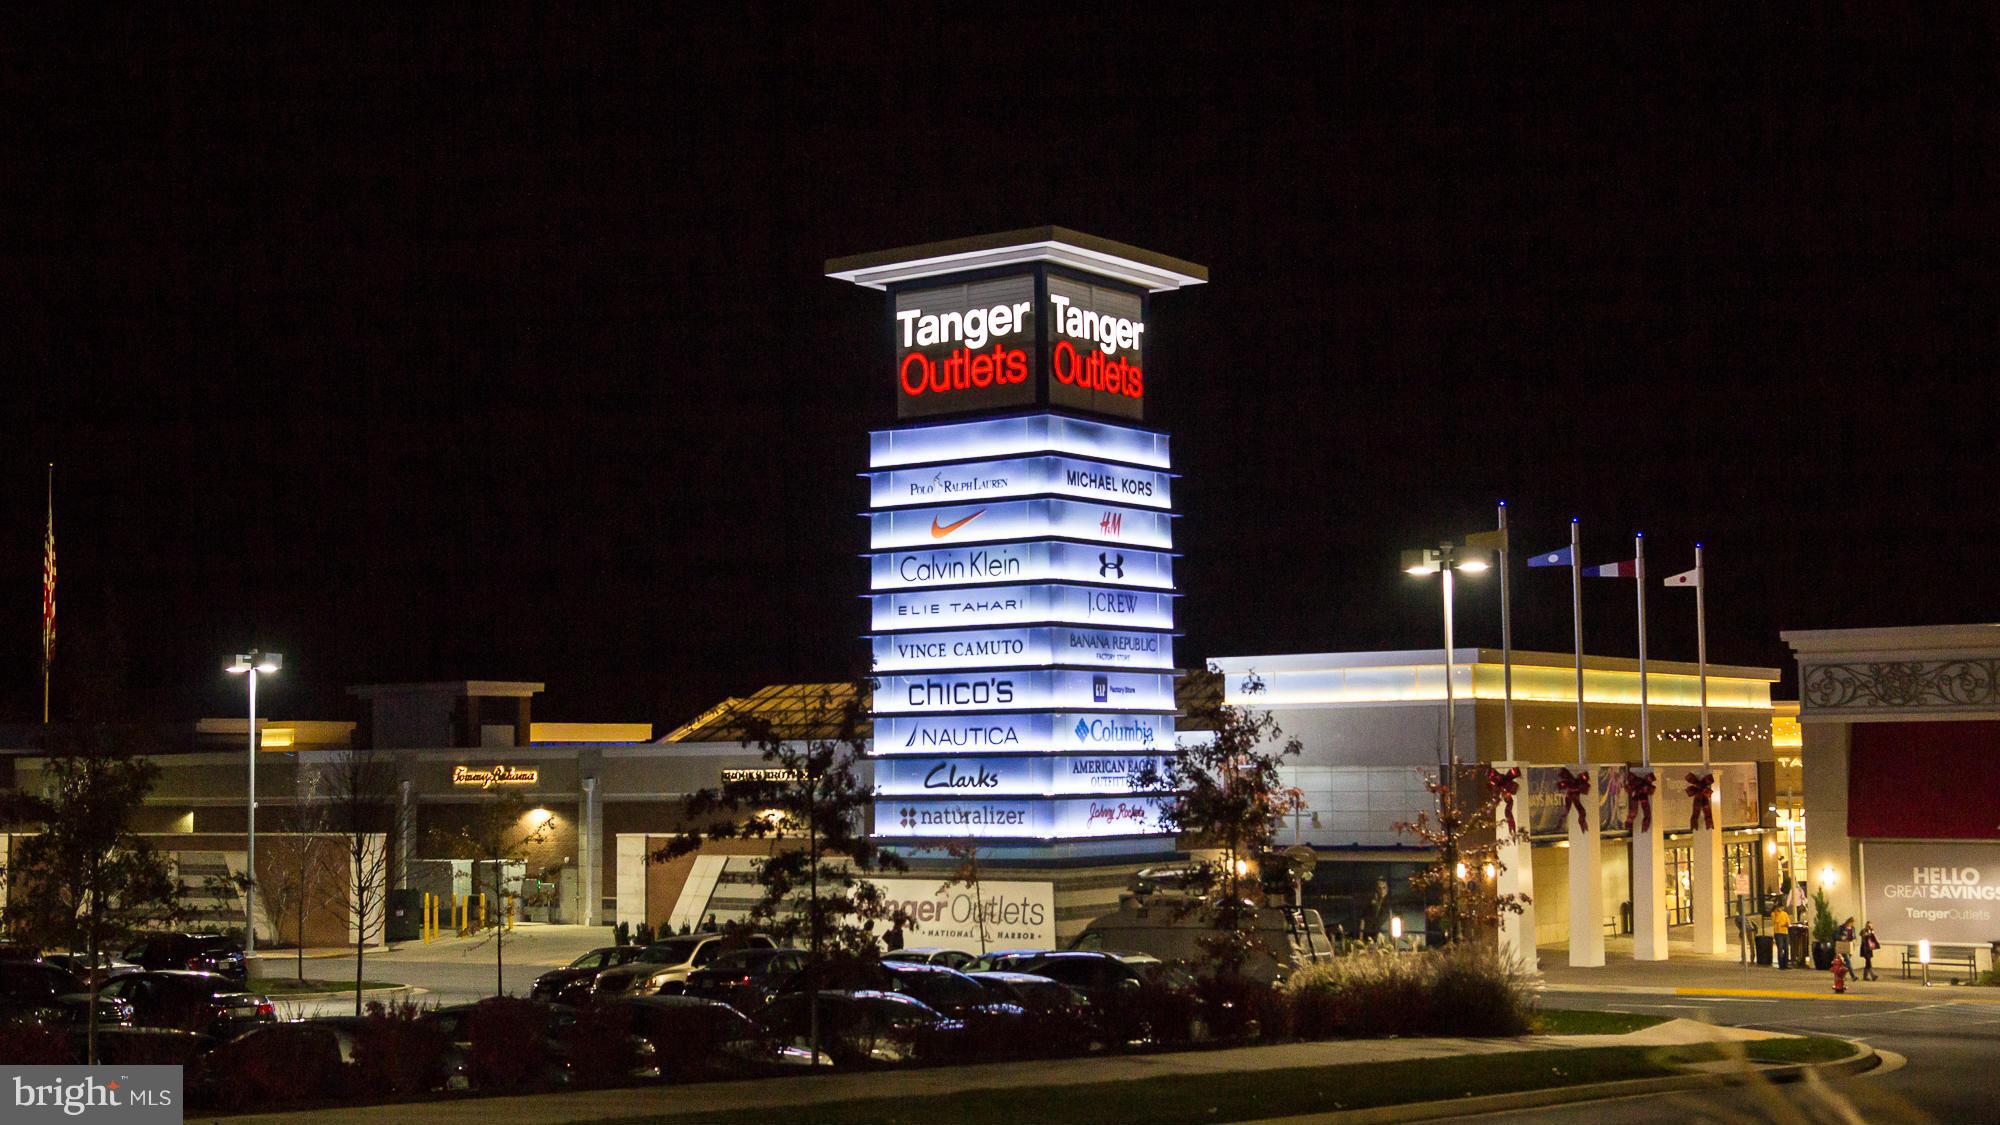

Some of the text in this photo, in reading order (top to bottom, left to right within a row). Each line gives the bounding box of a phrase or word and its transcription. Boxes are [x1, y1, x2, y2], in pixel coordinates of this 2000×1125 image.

[896, 301, 1031, 349] Tanger
[1050, 294, 1145, 354] Tanger
[901, 343, 1028, 396] Outlets
[1053, 340, 1143, 398] Outlets
[1066, 470, 1153, 497] MICHAEL KORS
[900, 549, 1020, 582] Calvin Klein
[898, 599, 1024, 616] ELIE TAHARI
[898, 639, 1024, 659] VINCE CAMUTO
[1069, 633, 1157, 652] BANANA REPUBLIC
[922, 727, 1019, 747] NAUTICA
[1090, 719, 1154, 742] Columbia
[923, 762, 999, 789] Clarks
[1072, 759, 1157, 774] AMERICAN EAG
[454, 766, 492, 789] Tommy
[920, 808, 1026, 826] naturalizer
[1913, 866, 1980, 886] HELLO
[1884, 884, 1928, 898] GREAT
[928, 929, 1035, 940] NATIONAL HARBOR
